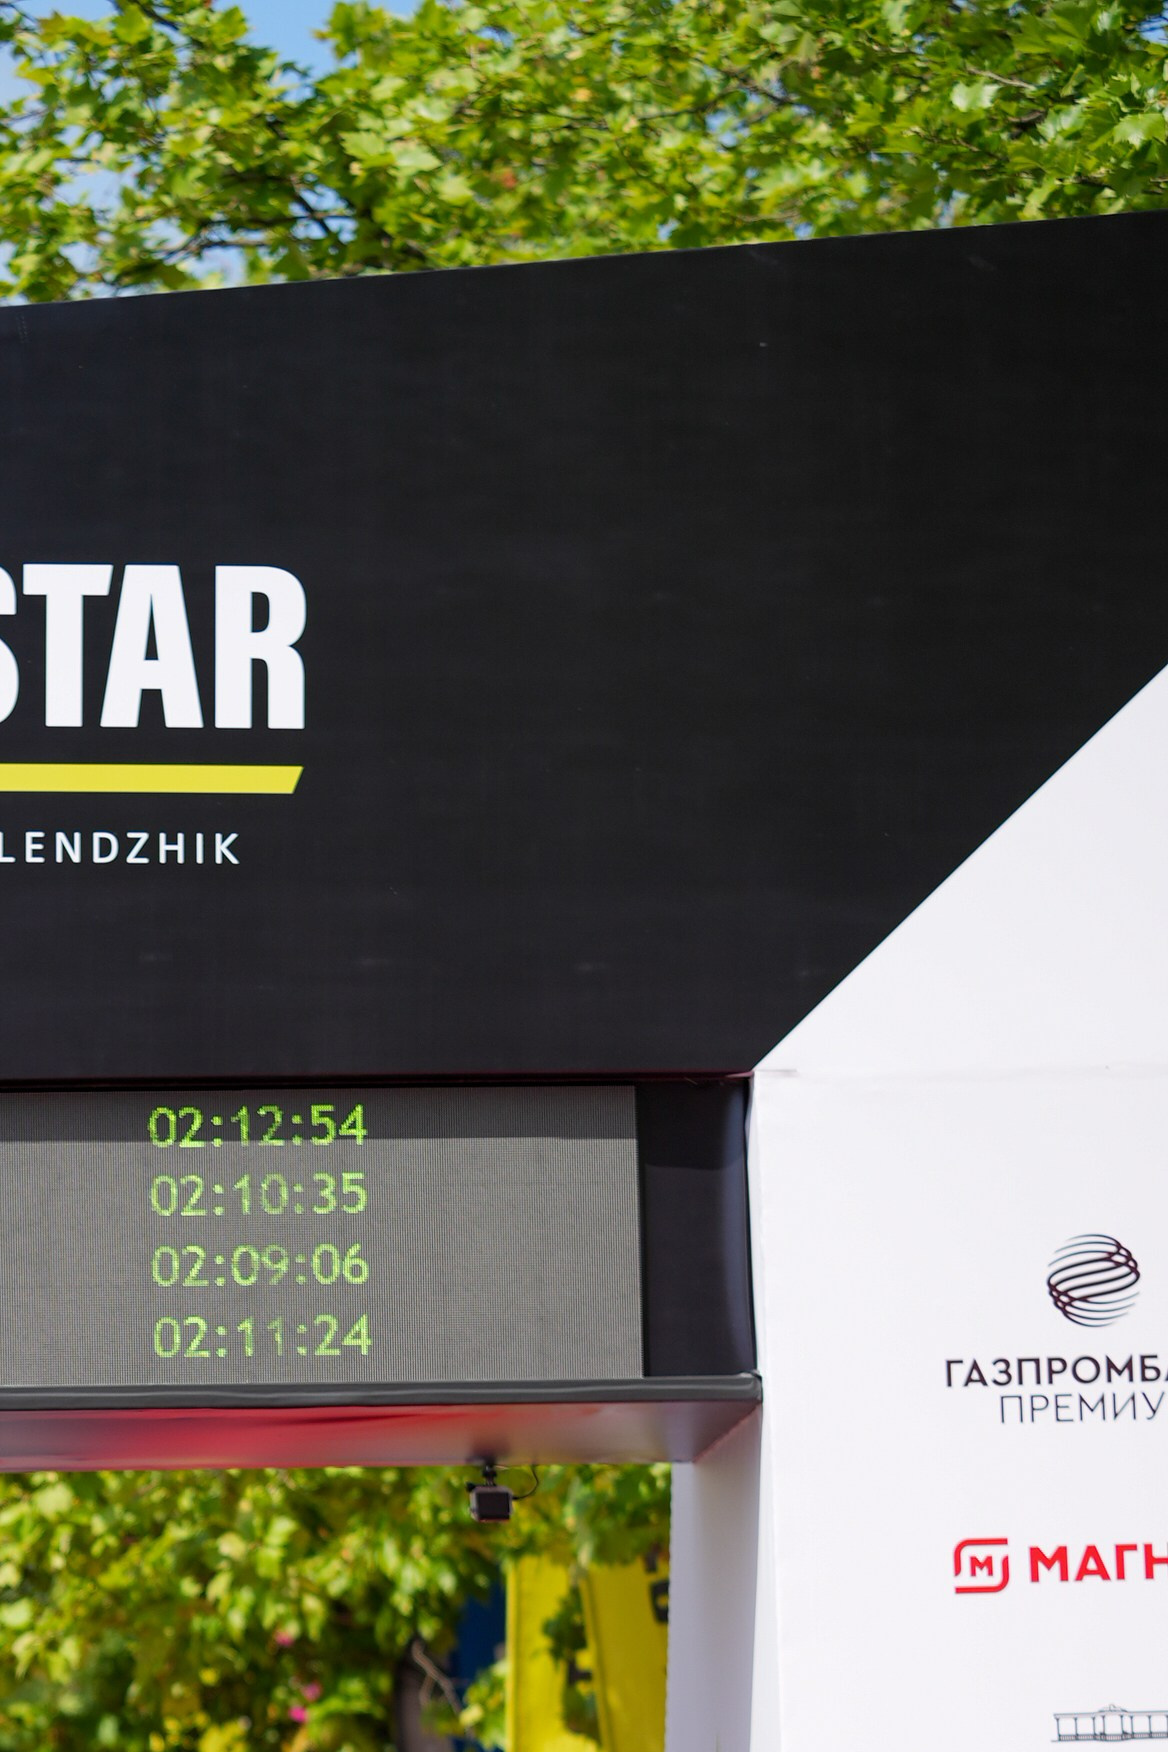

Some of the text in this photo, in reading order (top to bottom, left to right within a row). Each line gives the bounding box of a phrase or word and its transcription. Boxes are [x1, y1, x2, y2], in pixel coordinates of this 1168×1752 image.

[147, 1104, 369, 1148] 02:12:54
[149, 1172, 369, 1217] 02:10:35
[150, 1243, 370, 1287] 02:09:06
[153, 1314, 373, 1358] 02:11:24
[945, 1354, 1168, 1388] ГАЗПРОМБ
